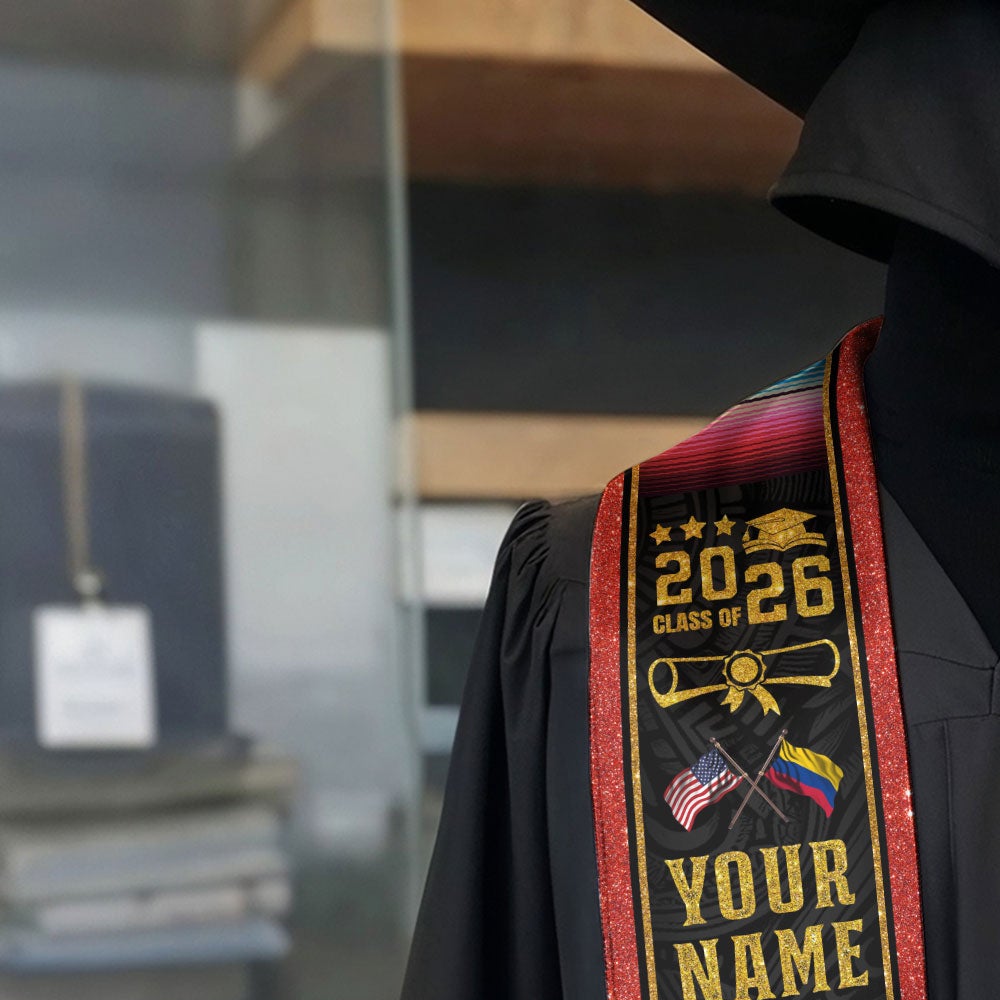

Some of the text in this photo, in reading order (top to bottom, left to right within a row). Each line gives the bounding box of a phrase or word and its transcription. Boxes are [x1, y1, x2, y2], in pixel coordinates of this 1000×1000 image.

[652, 606, 742, 635] CLASS OF
[655, 545, 835, 625] 2026
[664, 838, 856, 927] YOUR
